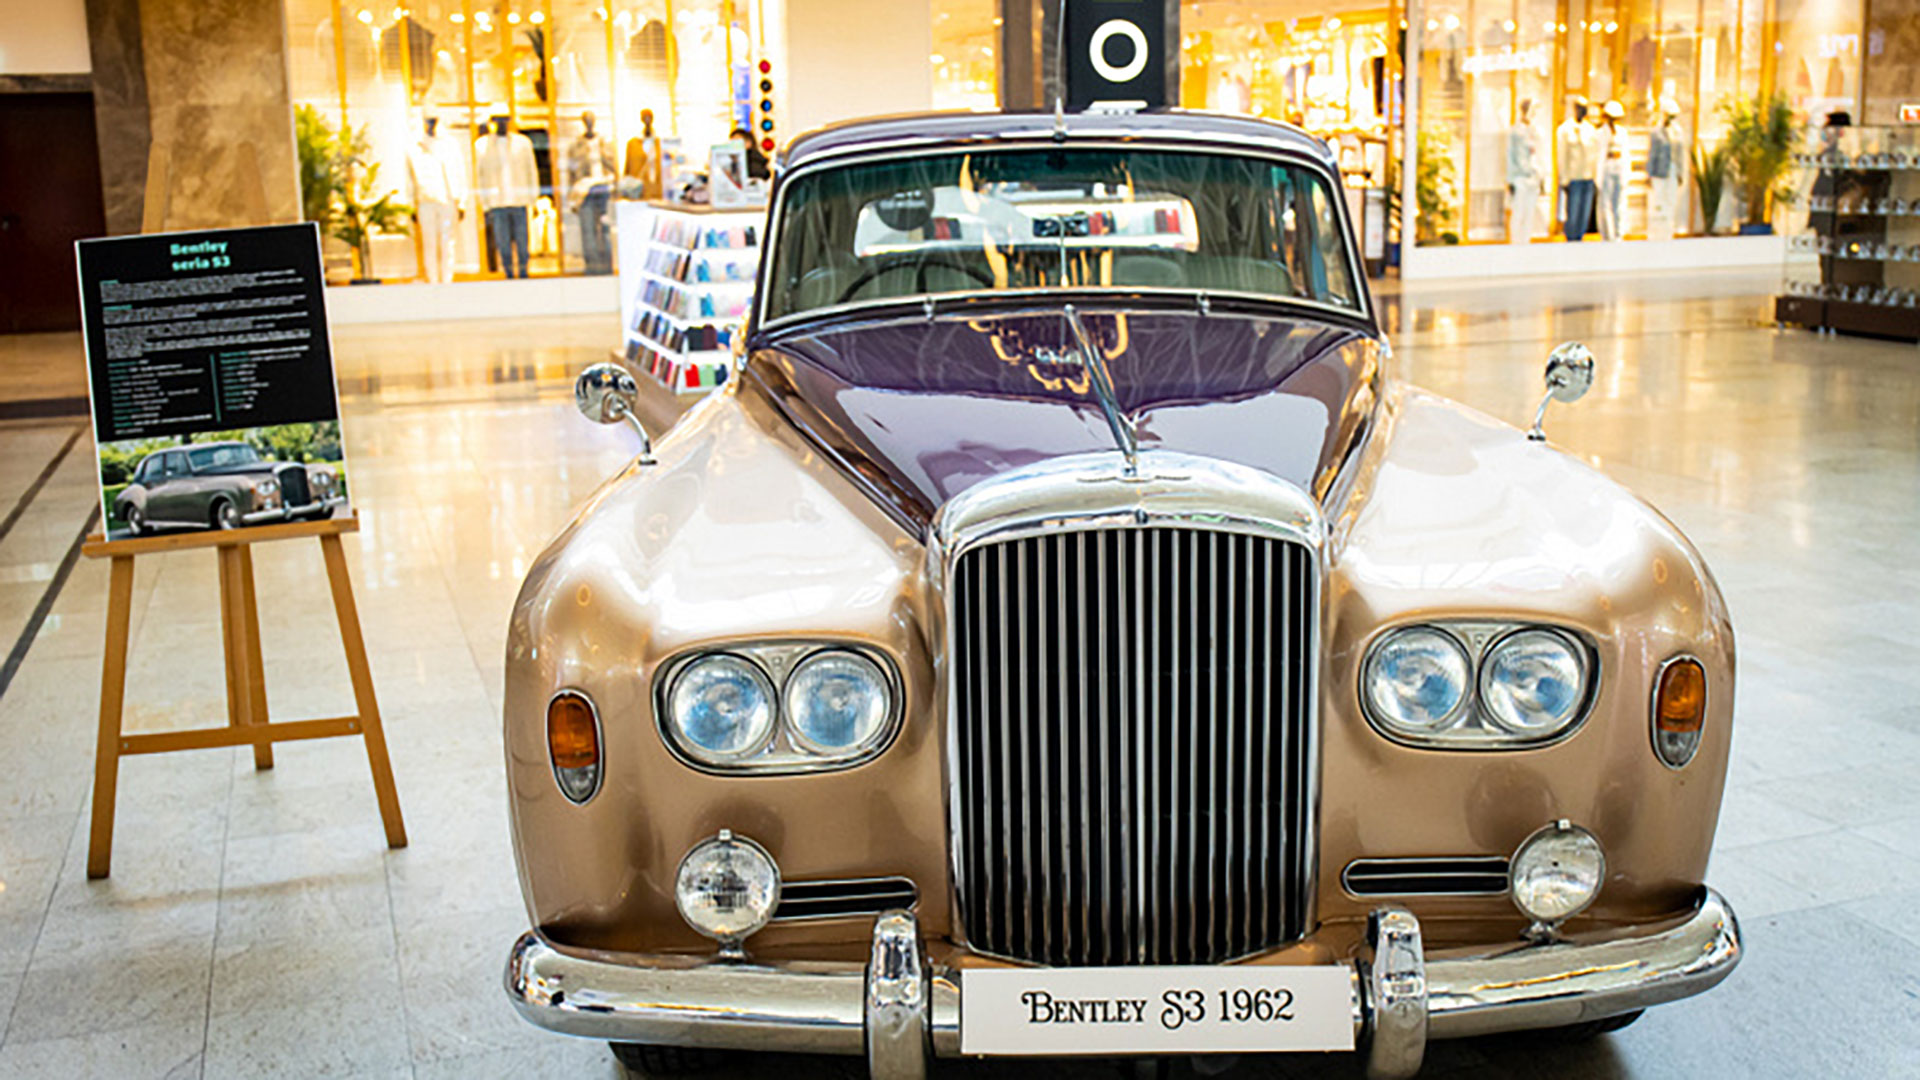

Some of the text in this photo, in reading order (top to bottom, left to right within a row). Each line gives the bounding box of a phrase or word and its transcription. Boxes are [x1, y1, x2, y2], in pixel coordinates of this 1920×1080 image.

[170, 240, 228, 256] Bentley
[172, 255, 230, 271] seria S3
[1161, 990, 1206, 1030] S3
[1219, 988, 1294, 1022] 1962
